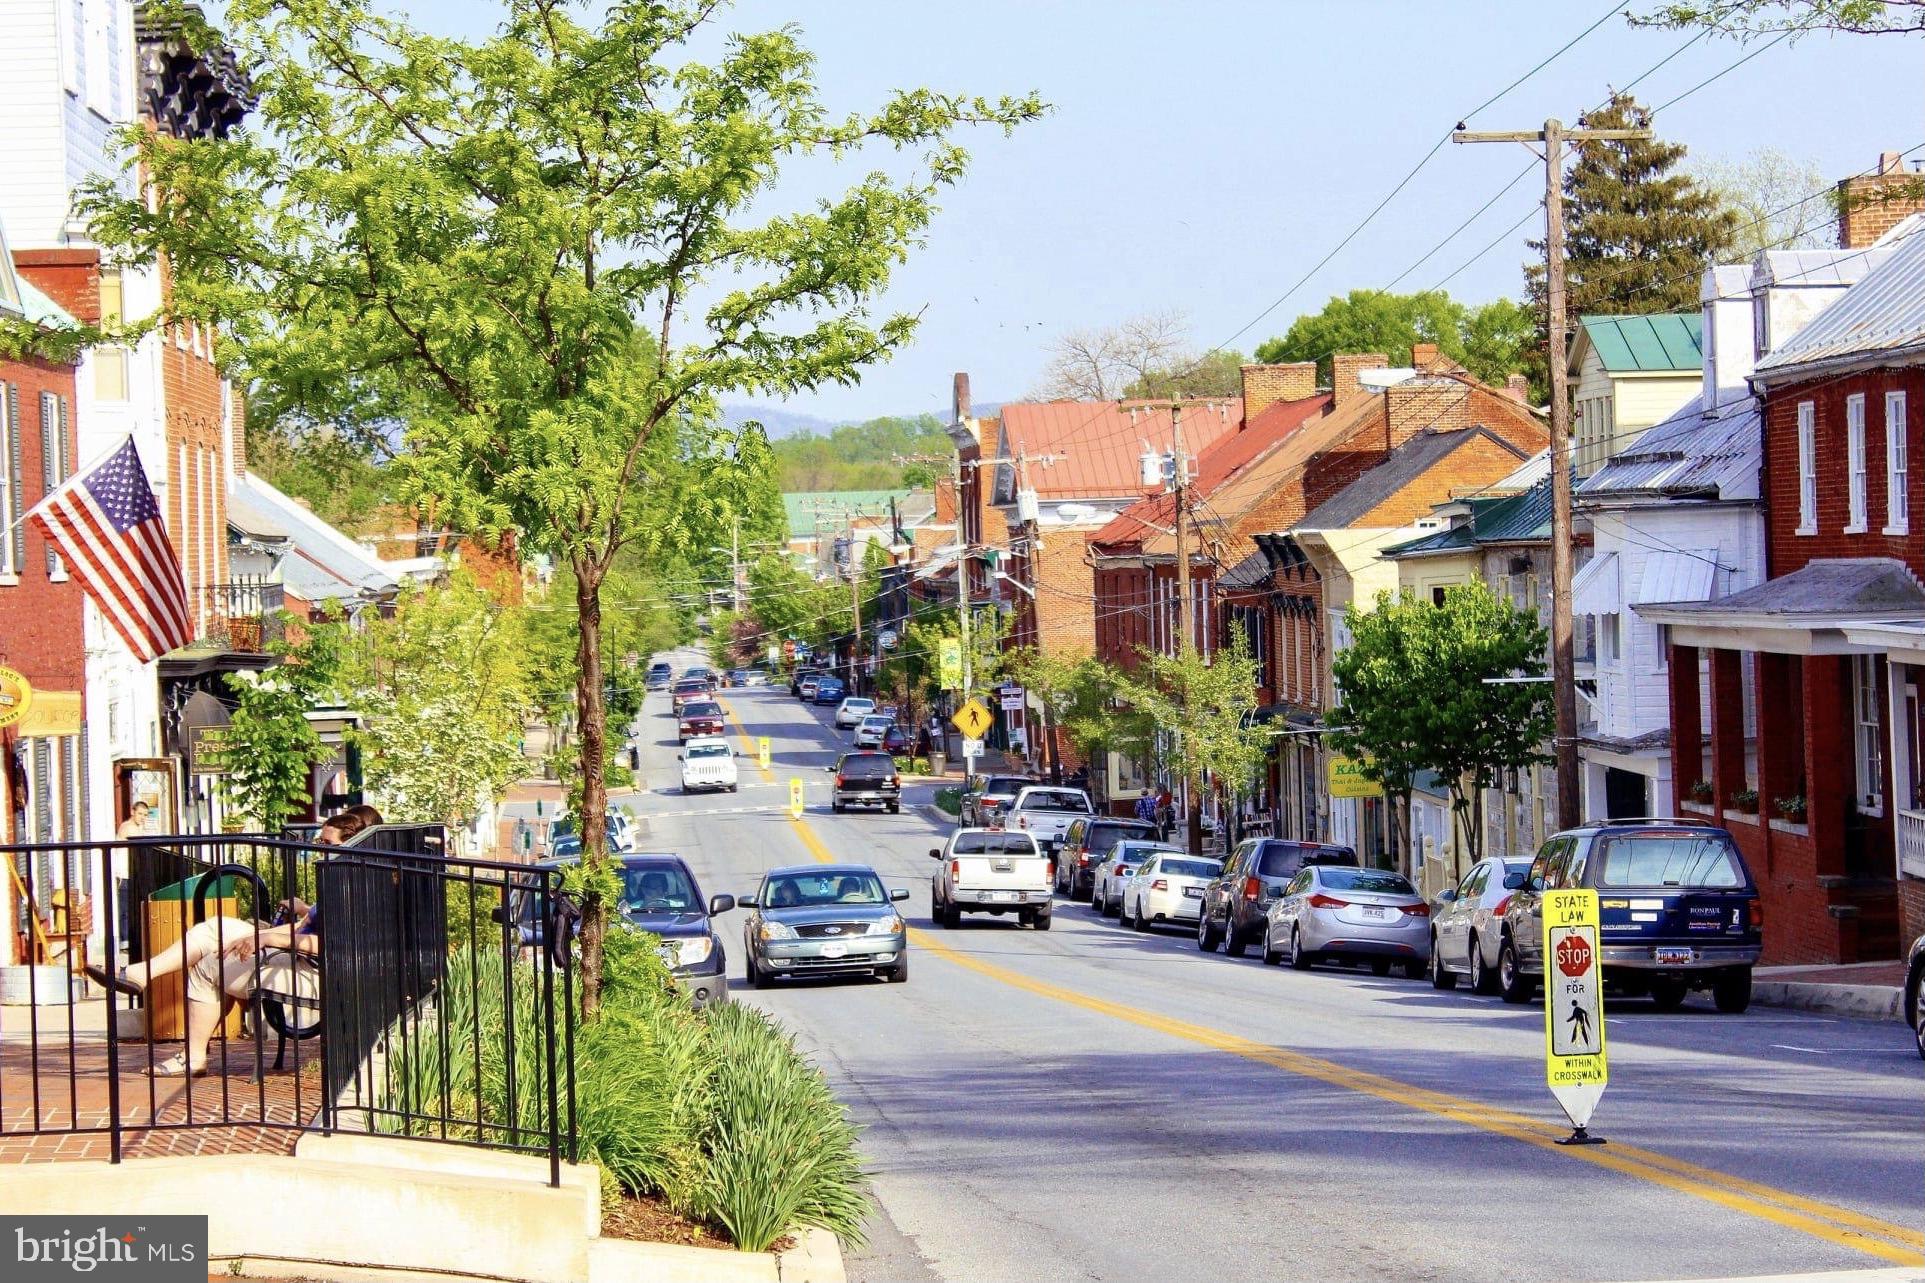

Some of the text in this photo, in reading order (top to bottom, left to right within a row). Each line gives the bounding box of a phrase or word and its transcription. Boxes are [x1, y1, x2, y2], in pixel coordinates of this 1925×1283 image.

[1555, 896, 1589, 908] STATE
[1560, 911, 1584, 923] LAW
[1558, 949, 1590, 965] STOP
[1566, 983, 1585, 994] FOR
[1564, 1058, 1592, 1068] WITHIN
[1554, 1069, 1602, 1081] CROSSWALK
